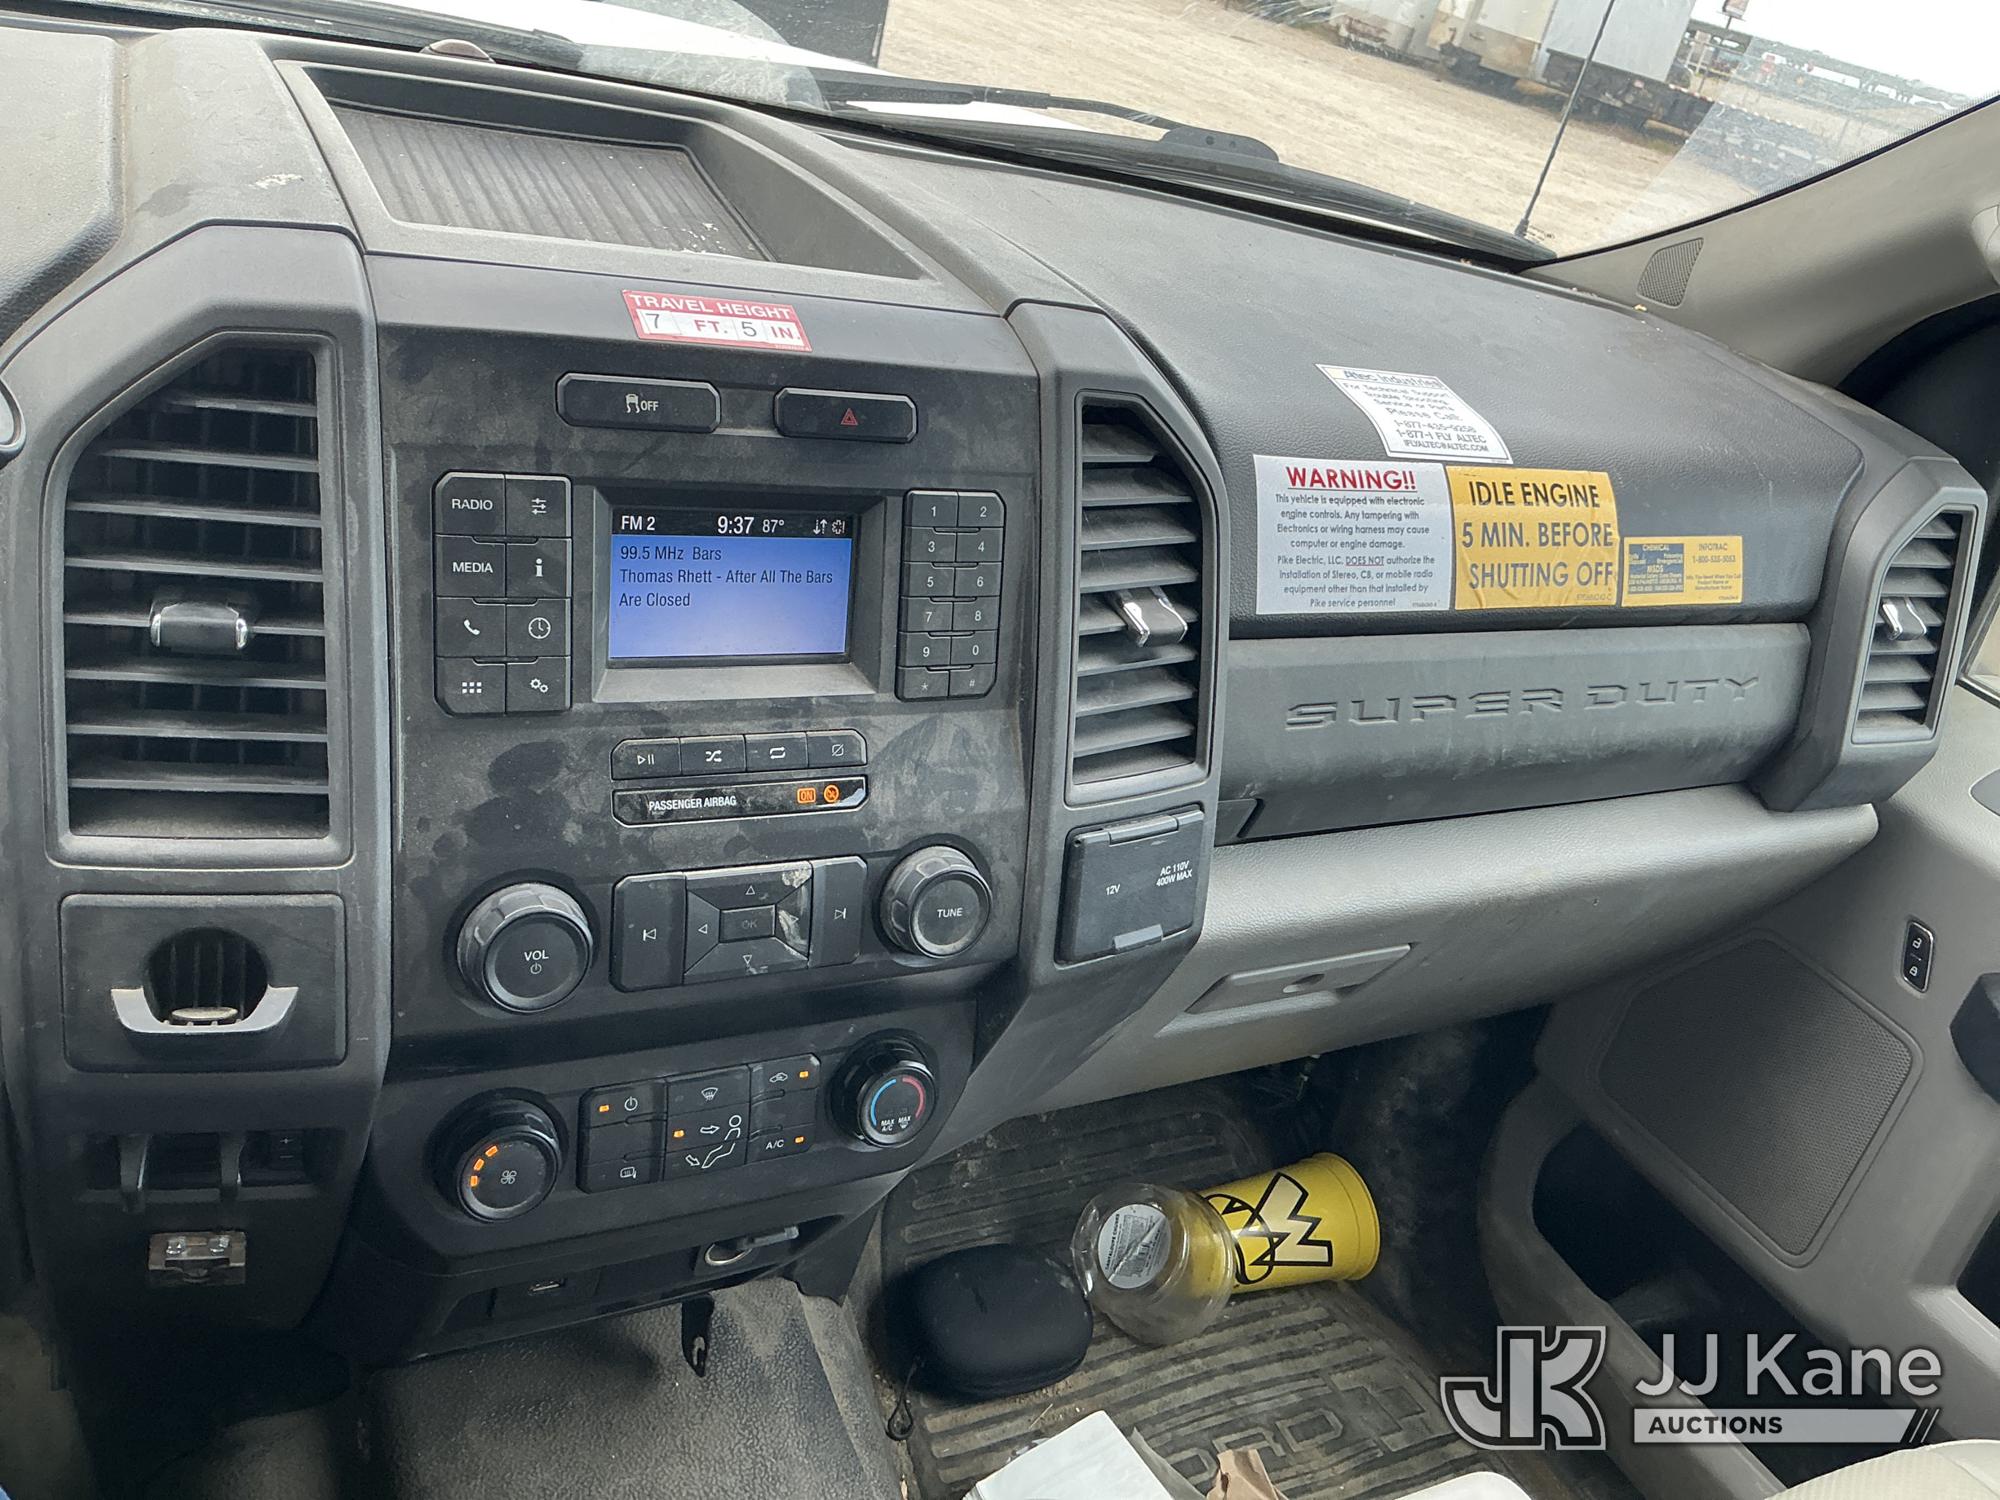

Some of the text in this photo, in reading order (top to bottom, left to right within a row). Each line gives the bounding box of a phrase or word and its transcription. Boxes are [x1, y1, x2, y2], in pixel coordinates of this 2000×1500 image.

[629, 294, 792, 319] TRAVEL HEIGHT
[645, 313, 661, 329] 7
[694, 319, 728, 333] FT.
[741, 321, 757, 337] 5
[1379, 373, 1444, 389] Industries
[641, 401, 659, 412] OFF
[1435, 431, 1452, 441] FLY
[1457, 433, 1487, 443] ALTEC
[1286, 466, 1417, 490] WARNING!!
[1275, 494, 1425, 507] This vehicle is equipped with electronic
[1469, 481, 1601, 508] IDLE ENGINE
[451, 499, 493, 511] RADIO
[931, 506, 987, 518] 1 2
[1280, 509, 1419, 521] engine controls. Any tampering with
[621, 516, 656, 531] FM 2
[717, 516, 754, 534] 9:37
[762, 519, 785, 534] 87°
[1277, 523, 1318, 533] Electronics
[1329, 524, 1353, 535] wiring
[1355, 524, 1385, 534] harness
[1387, 526, 1404, 536] may
[1406, 526, 1430, 534] cause
[1462, 522, 1614, 548] 5 MIN. BEFORE
[928, 541, 985, 553] 3 4
[1290, 539, 1328, 550] computer
[1340, 539, 1367, 550] engine
[1369, 539, 1405, 550] damage.
[620, 546, 722, 561] 99.5 MHz Bars
[1277, 555, 1294, 565] Pike
[1345, 556, 1367, 566] DOES
[1368, 556, 1384, 566] NOT
[1386, 556, 1422, 565] authorize
[1423, 556, 1435, 564] the
[452, 562, 494, 574] MEDIA
[1279, 570, 1321, 579] installation
[1322, 570, 1331, 579] of
[1385, 570, 1412, 579] mobile
[1414, 570, 1433, 578] radio
[620, 569, 673, 583] Thomas
[678, 569, 713, 583] Rhett
[725, 570, 756, 584] After
[760, 570, 776, 584] All
[779, 570, 802, 584] The
[806, 570, 833, 584] Bars
[927, 575, 984, 588] 5 6
[1469, 561, 1614, 589] SHUTTING OFF
[1283, 583, 1429, 596] equipment other than that installed by
[619, 593, 690, 607] Are Closed
[1310, 598, 1396, 609] Pike service personnel
[925, 610, 982, 623] 7 8
[922, 645, 980, 658] 9 0
[1284, 676, 1760, 732] SUPER DUTY
[799, 790, 814, 801] ON
[649, 795, 737, 811] PASSENGER AIRBAG
[1160, 860, 1190, 876] AC 110V
[1156, 870, 1193, 887] 400W MAX
[1105, 884, 1121, 896] 12V
[937, 907, 964, 919] TUNE
[741, 918, 758, 930] OK
[523, 949, 549, 962] VOL
[765, 1139, 785, 1150] A/C
